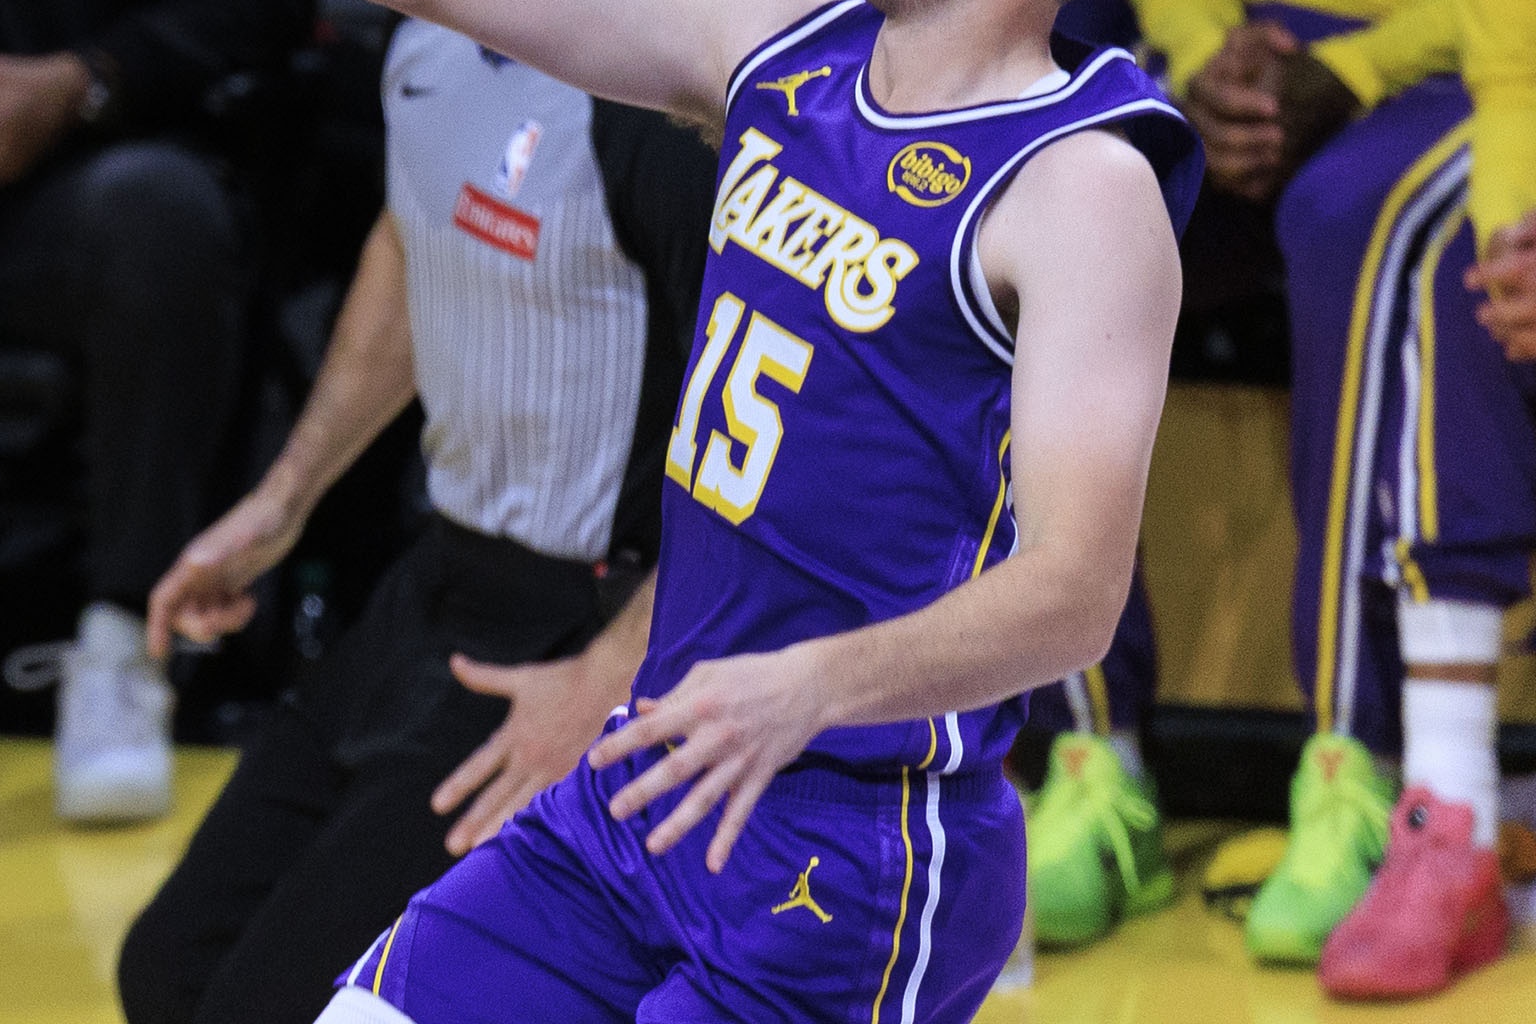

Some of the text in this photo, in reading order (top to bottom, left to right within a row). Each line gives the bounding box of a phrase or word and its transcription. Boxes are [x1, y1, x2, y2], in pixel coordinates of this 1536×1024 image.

[709, 126, 920, 333] LAKERS
[900, 148, 961, 194] bibigo
[665, 290, 814, 527] 15
